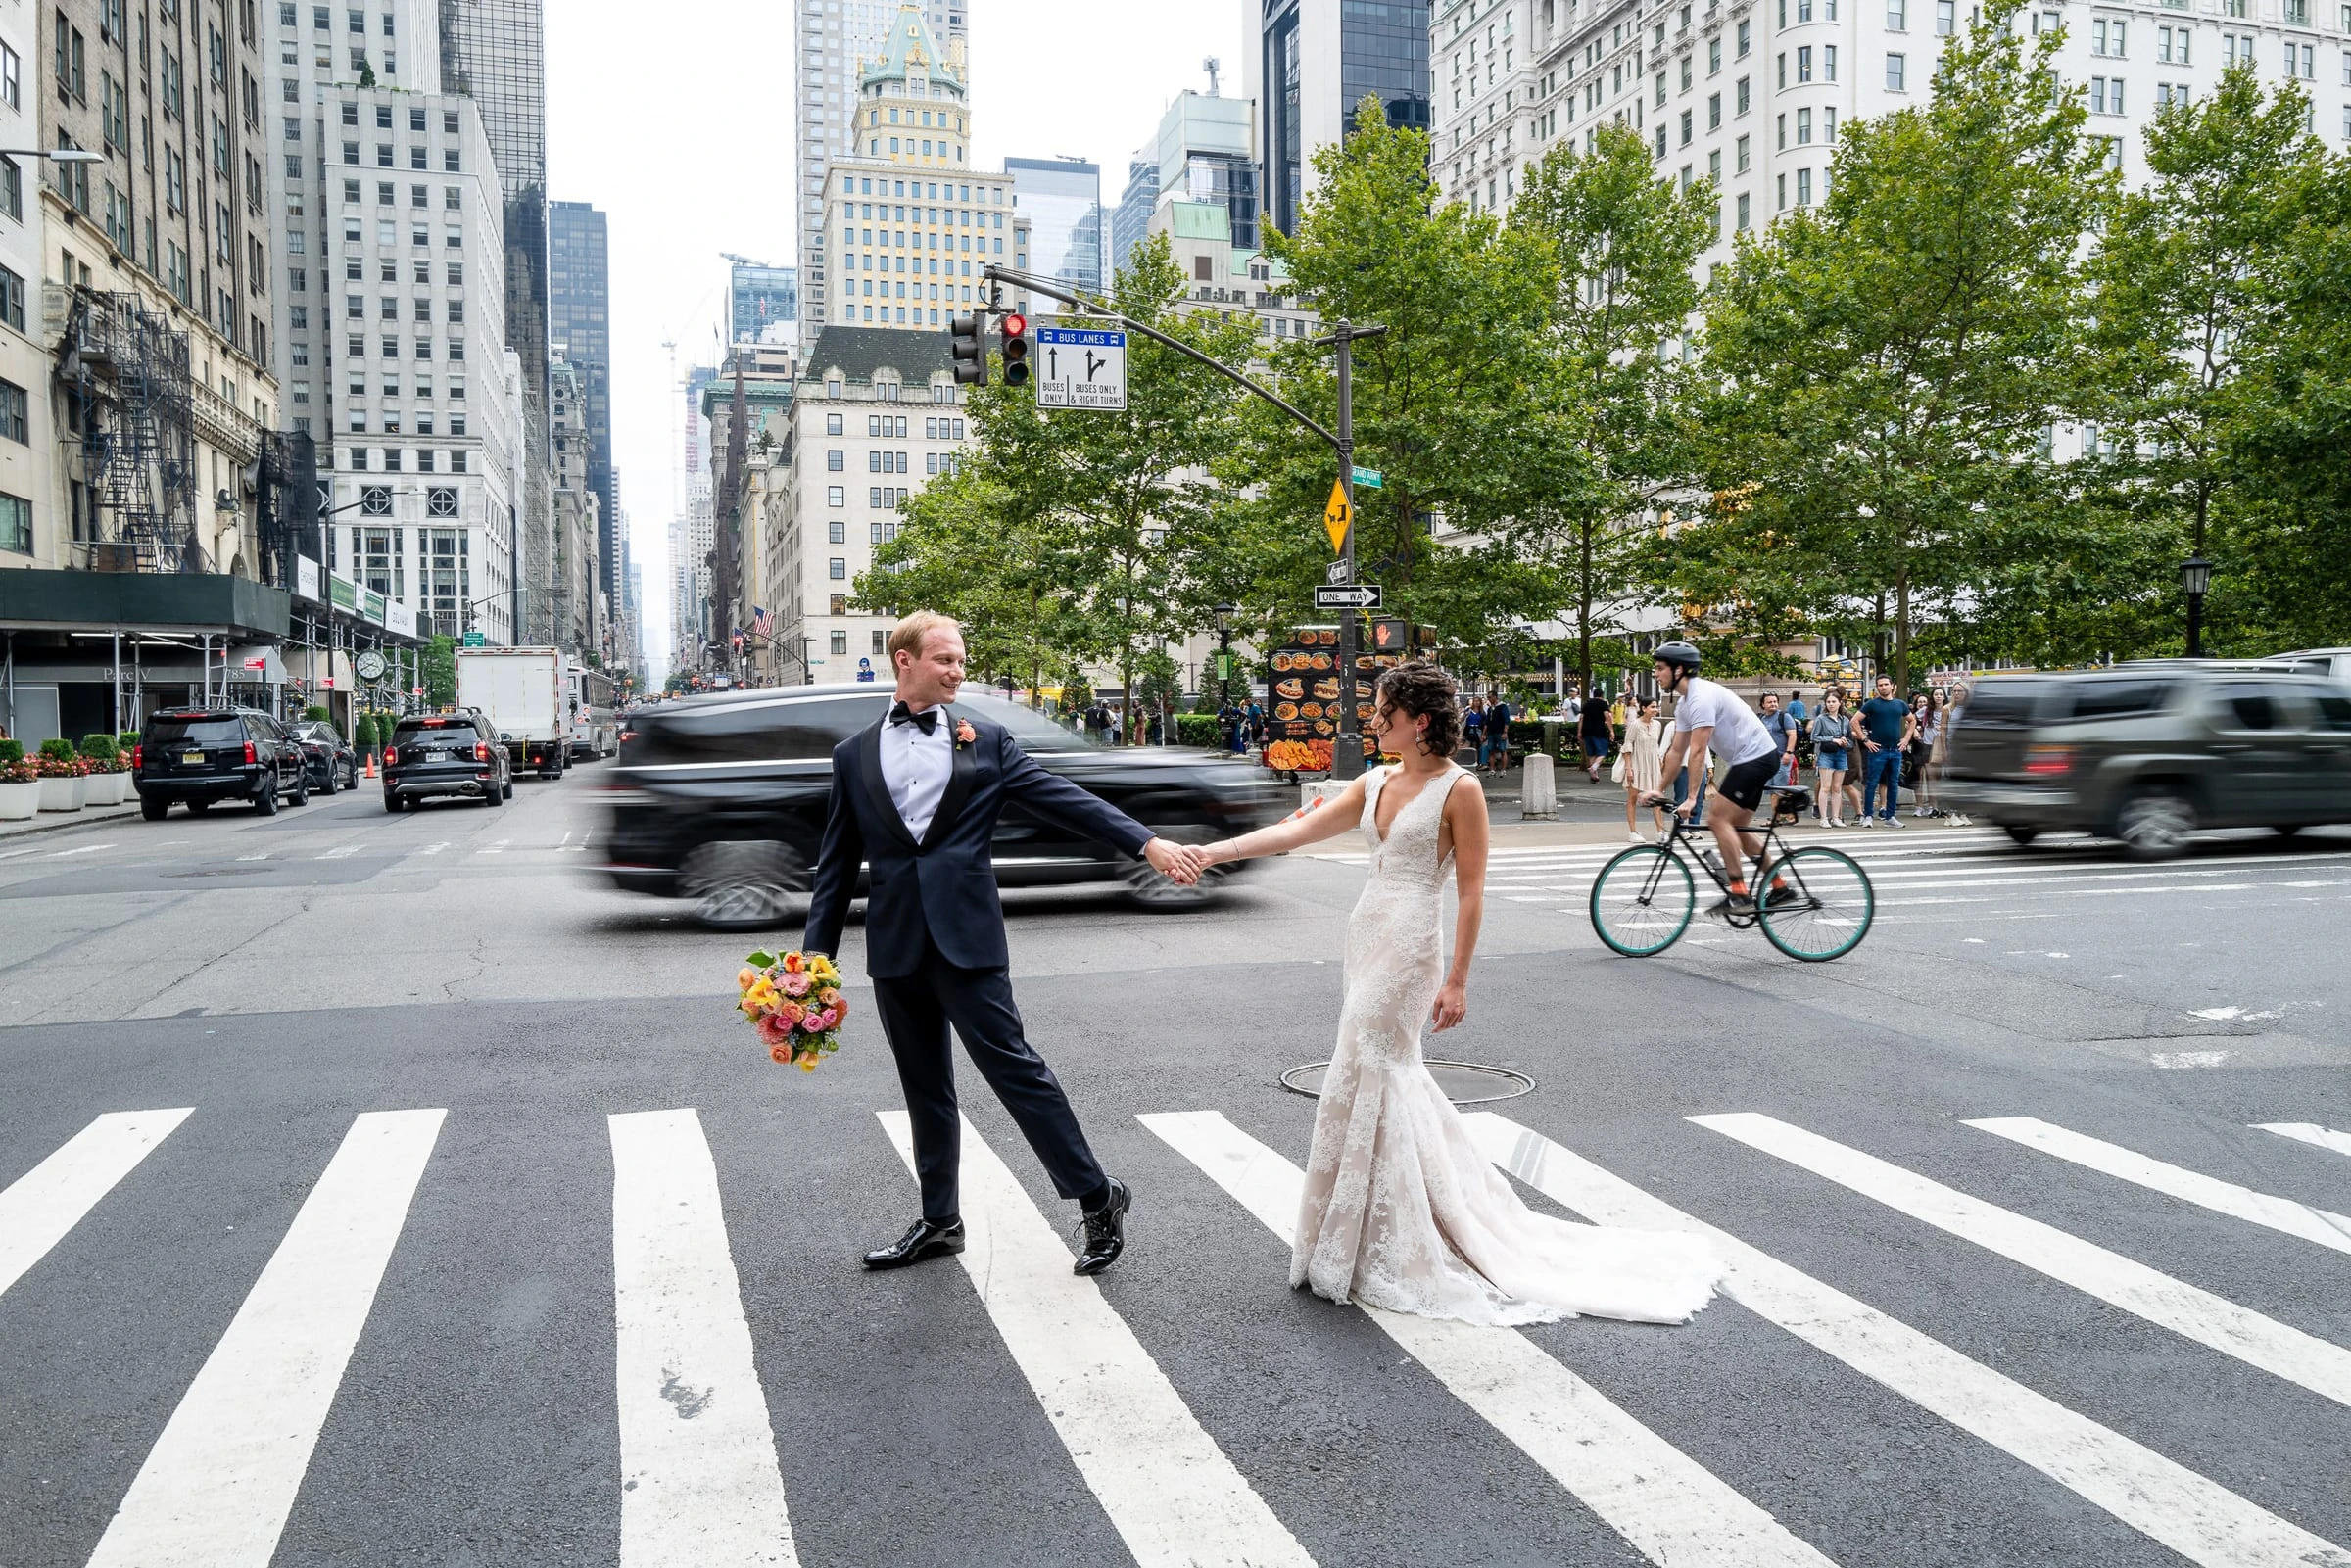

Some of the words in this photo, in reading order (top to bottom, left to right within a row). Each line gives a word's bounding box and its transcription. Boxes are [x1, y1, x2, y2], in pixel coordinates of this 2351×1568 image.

[1059, 333, 1076, 343] BUS
[1079, 334, 1105, 344] LANES
[1042, 382, 1064, 392] BUSES
[1075, 383, 1097, 394] BUSES
[1099, 385, 1117, 394] ONLY
[1044, 394, 1062, 403] ONLY
[1071, 395, 1076, 404] &
[1079, 395, 1097, 404] RIGHT
[1100, 396, 1122, 405] TURNS
[1322, 593, 1340, 601] ONE
[1349, 593, 1368, 601] WAY
[226, 668, 245, 679] 785
